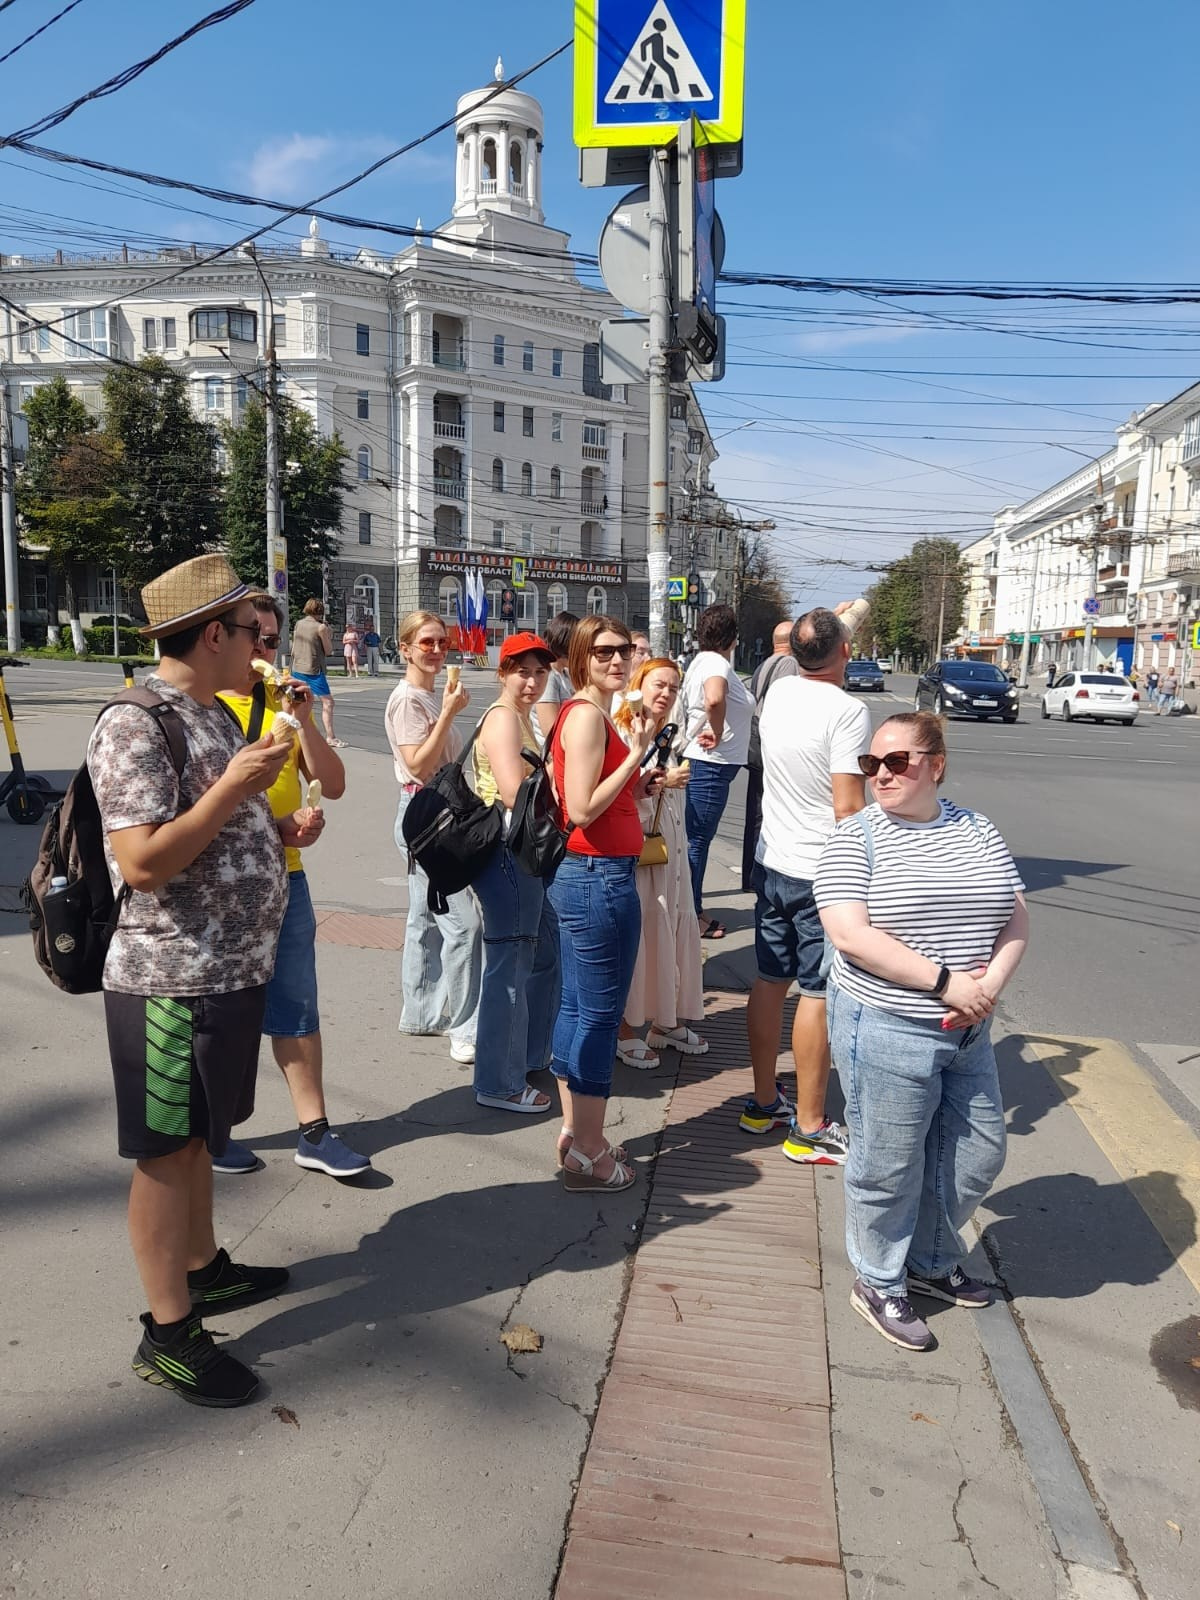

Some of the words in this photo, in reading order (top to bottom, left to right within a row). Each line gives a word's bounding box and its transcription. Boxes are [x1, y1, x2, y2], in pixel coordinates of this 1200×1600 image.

[427, 562, 476, 573] ТУЛЬСКАЯ
[478, 566, 529, 577] ОБЛАСТЯ
[530, 570, 568, 580] ДЕТСКАЯ
[569, 573, 622, 583] БИБЛИОТЕКА
